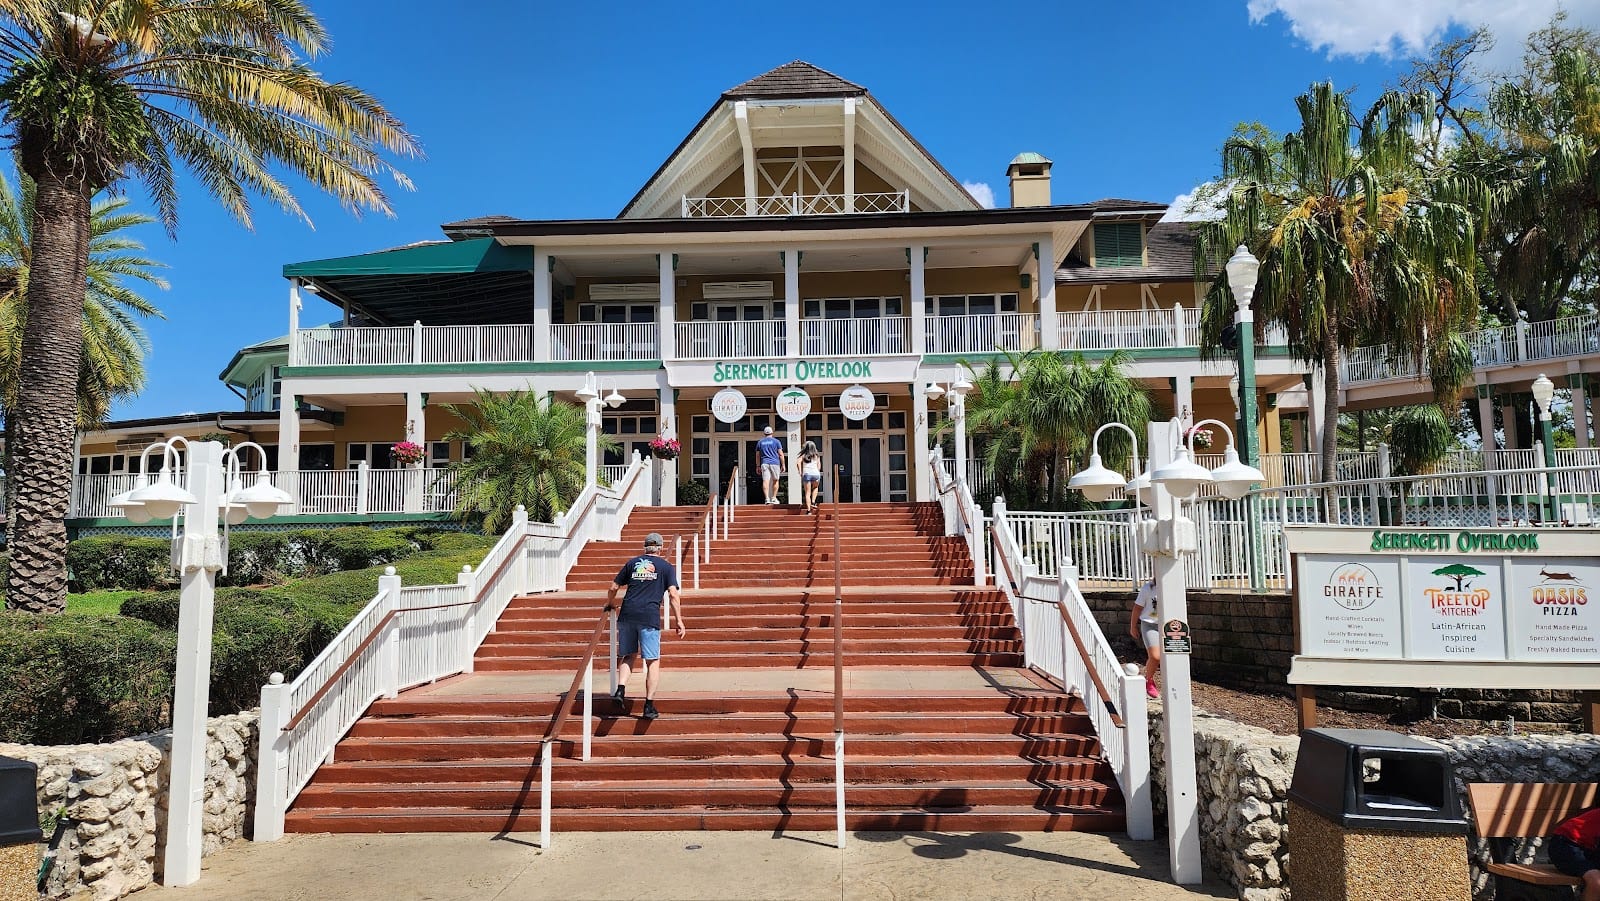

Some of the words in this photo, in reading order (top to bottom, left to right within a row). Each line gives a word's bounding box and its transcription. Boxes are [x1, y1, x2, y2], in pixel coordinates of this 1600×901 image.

[713, 361, 788, 383] SERENGETI
[795, 360, 872, 381] OVERLOOK
[1370, 529, 1450, 551] SERENGETI
[1456, 531, 1540, 552] OVERLOOK
[1324, 585, 1384, 599] GIRAFFE
[1532, 586, 1588, 606] OASIS
[1346, 598, 1363, 607] BAR
[1423, 587, 1491, 610] TREETOP
[1441, 607, 1478, 617] KITCHEN
[1543, 606, 1578, 616] PIZZA
[1431, 622, 1486, 631] Latin-African
[1442, 634, 1477, 643] Inspired
[1529, 635, 1558, 643] Specialty
[1445, 645, 1476, 653] Cuisine
[1527, 646, 1550, 654] Freshly
